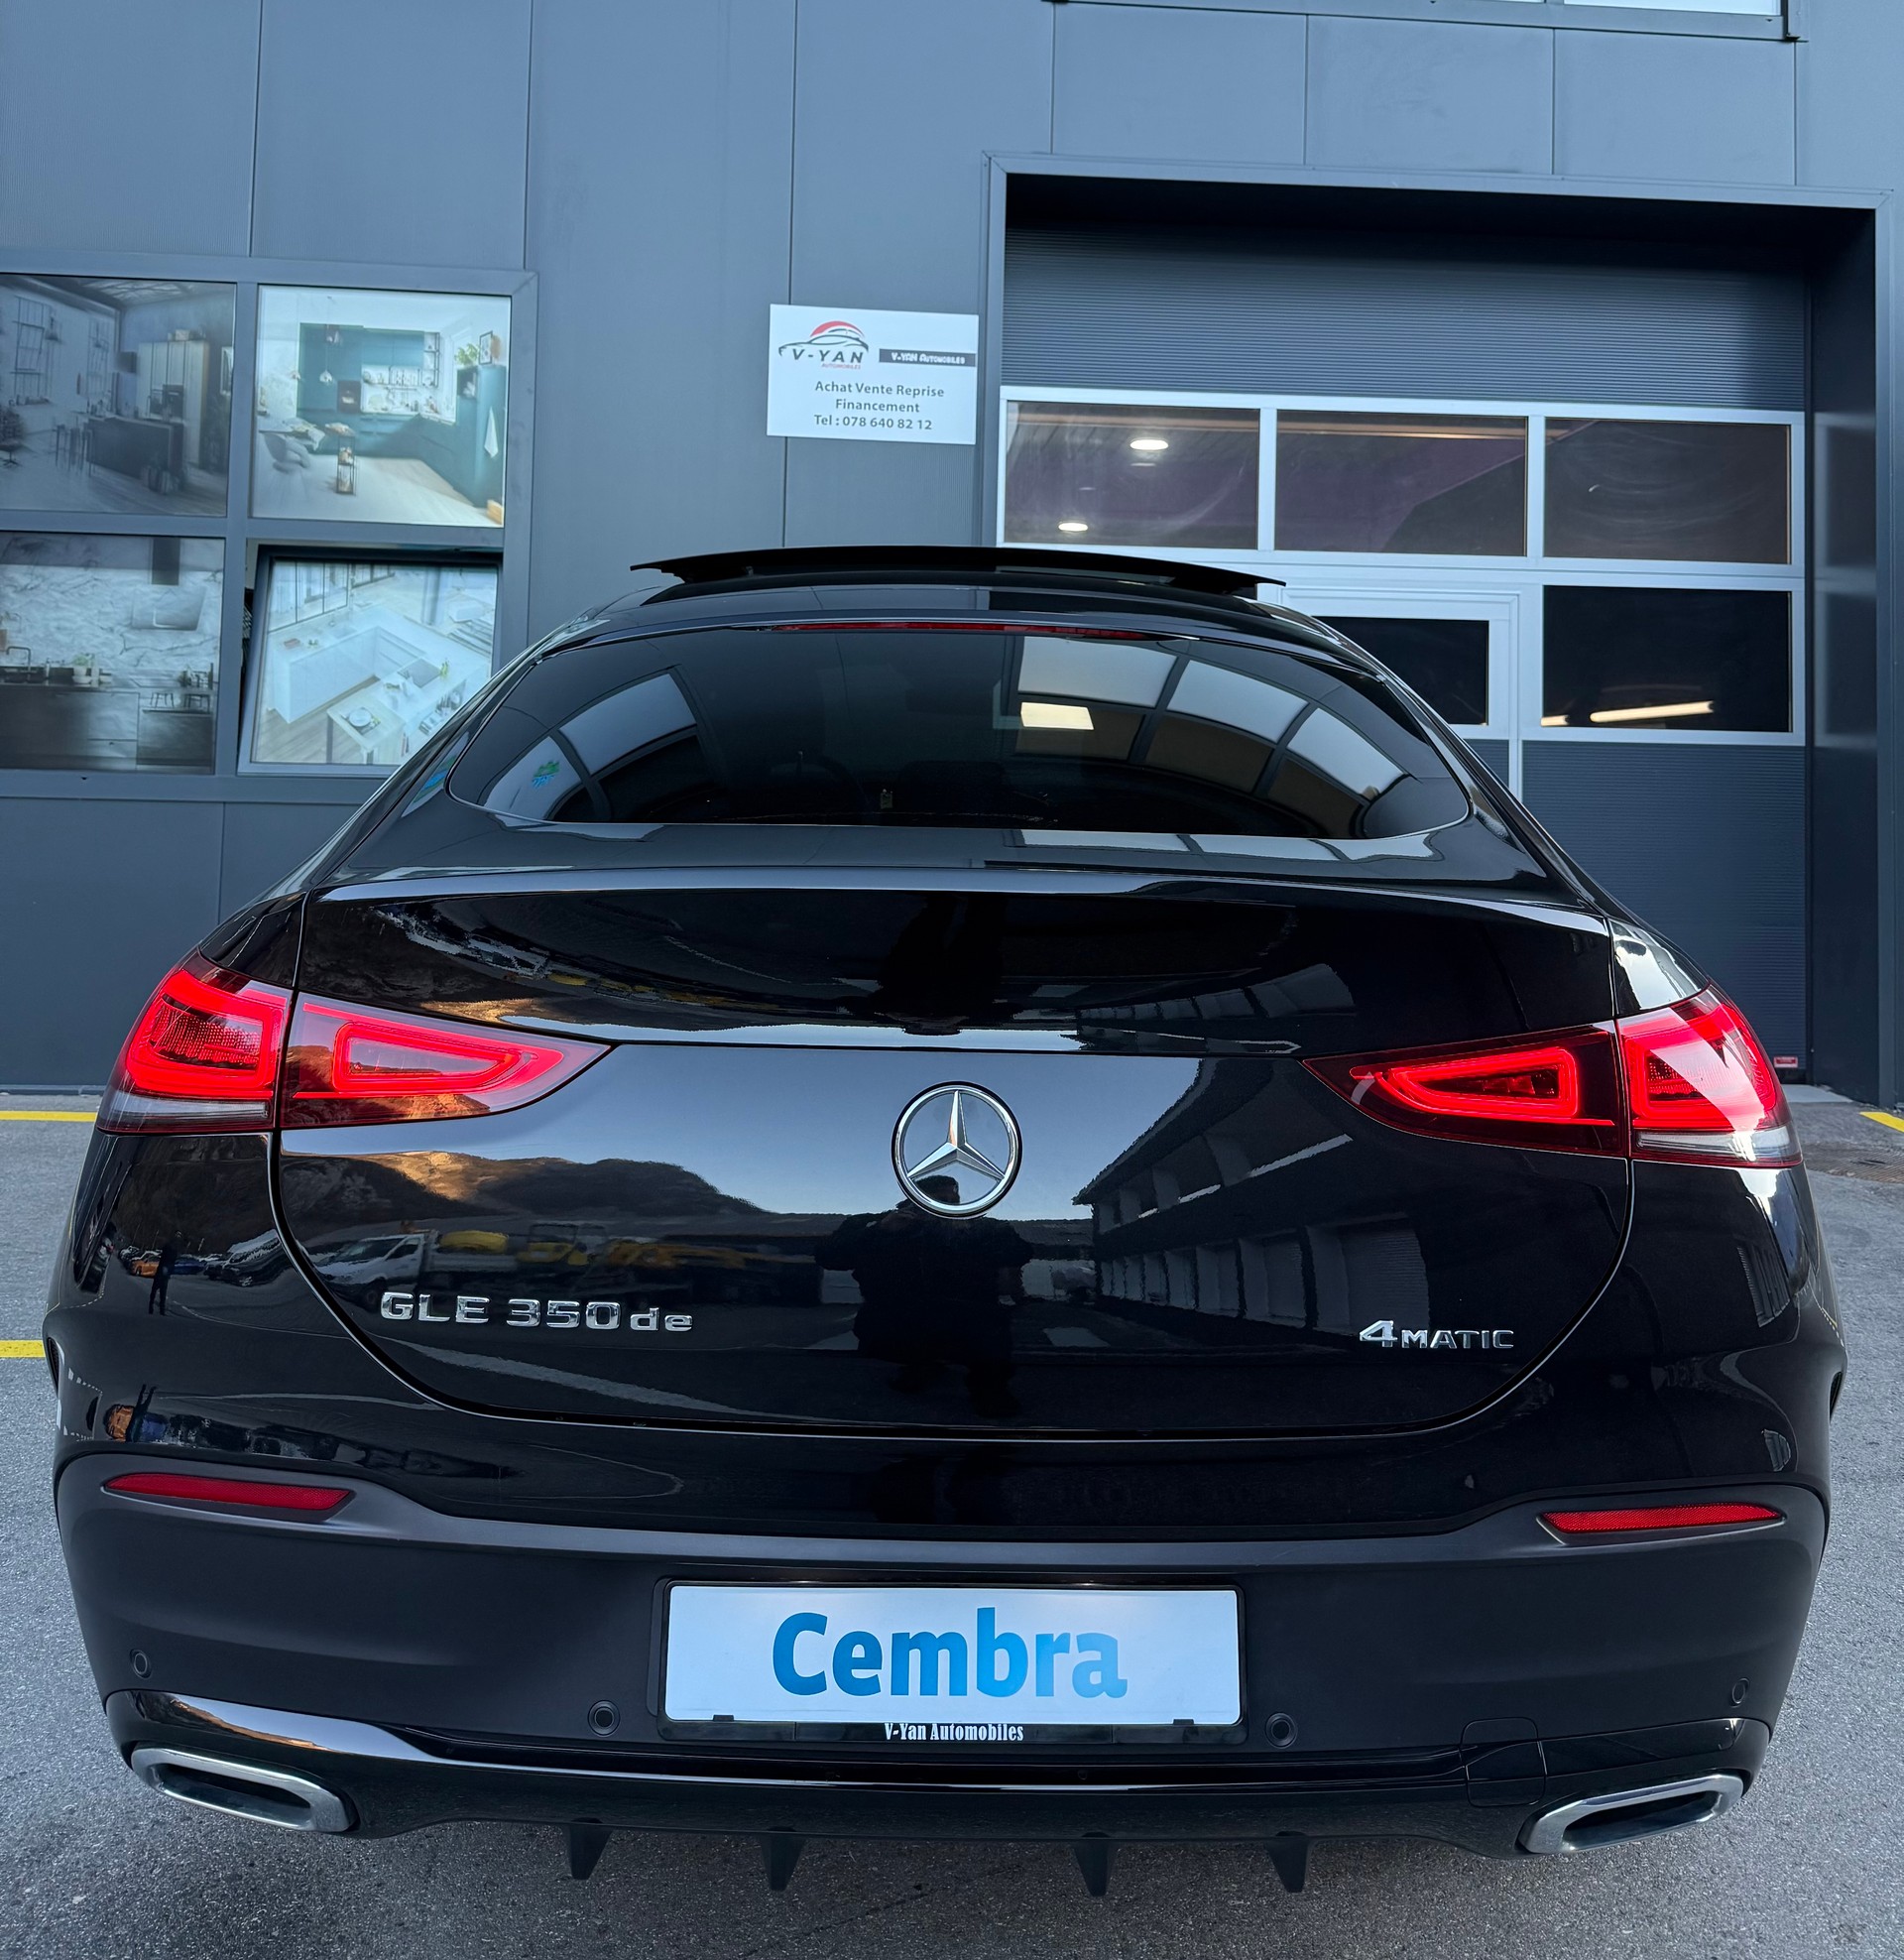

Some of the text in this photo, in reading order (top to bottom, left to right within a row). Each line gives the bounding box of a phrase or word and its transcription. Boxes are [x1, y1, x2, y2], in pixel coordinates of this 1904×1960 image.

[792, 348, 864, 363] V-YAN
[815, 381, 944, 398] Achat Vente Reprise
[836, 399, 919, 412] Financement
[843, 417, 867, 428] 078
[870, 418, 893, 428] 640
[897, 419, 912, 429] 82
[918, 420, 932, 429] 12
[381, 1291, 490, 1324] GLE
[773, 1607, 1128, 1698] Cembra
[884, 1722, 1024, 1742] V-Yan Automobiles
